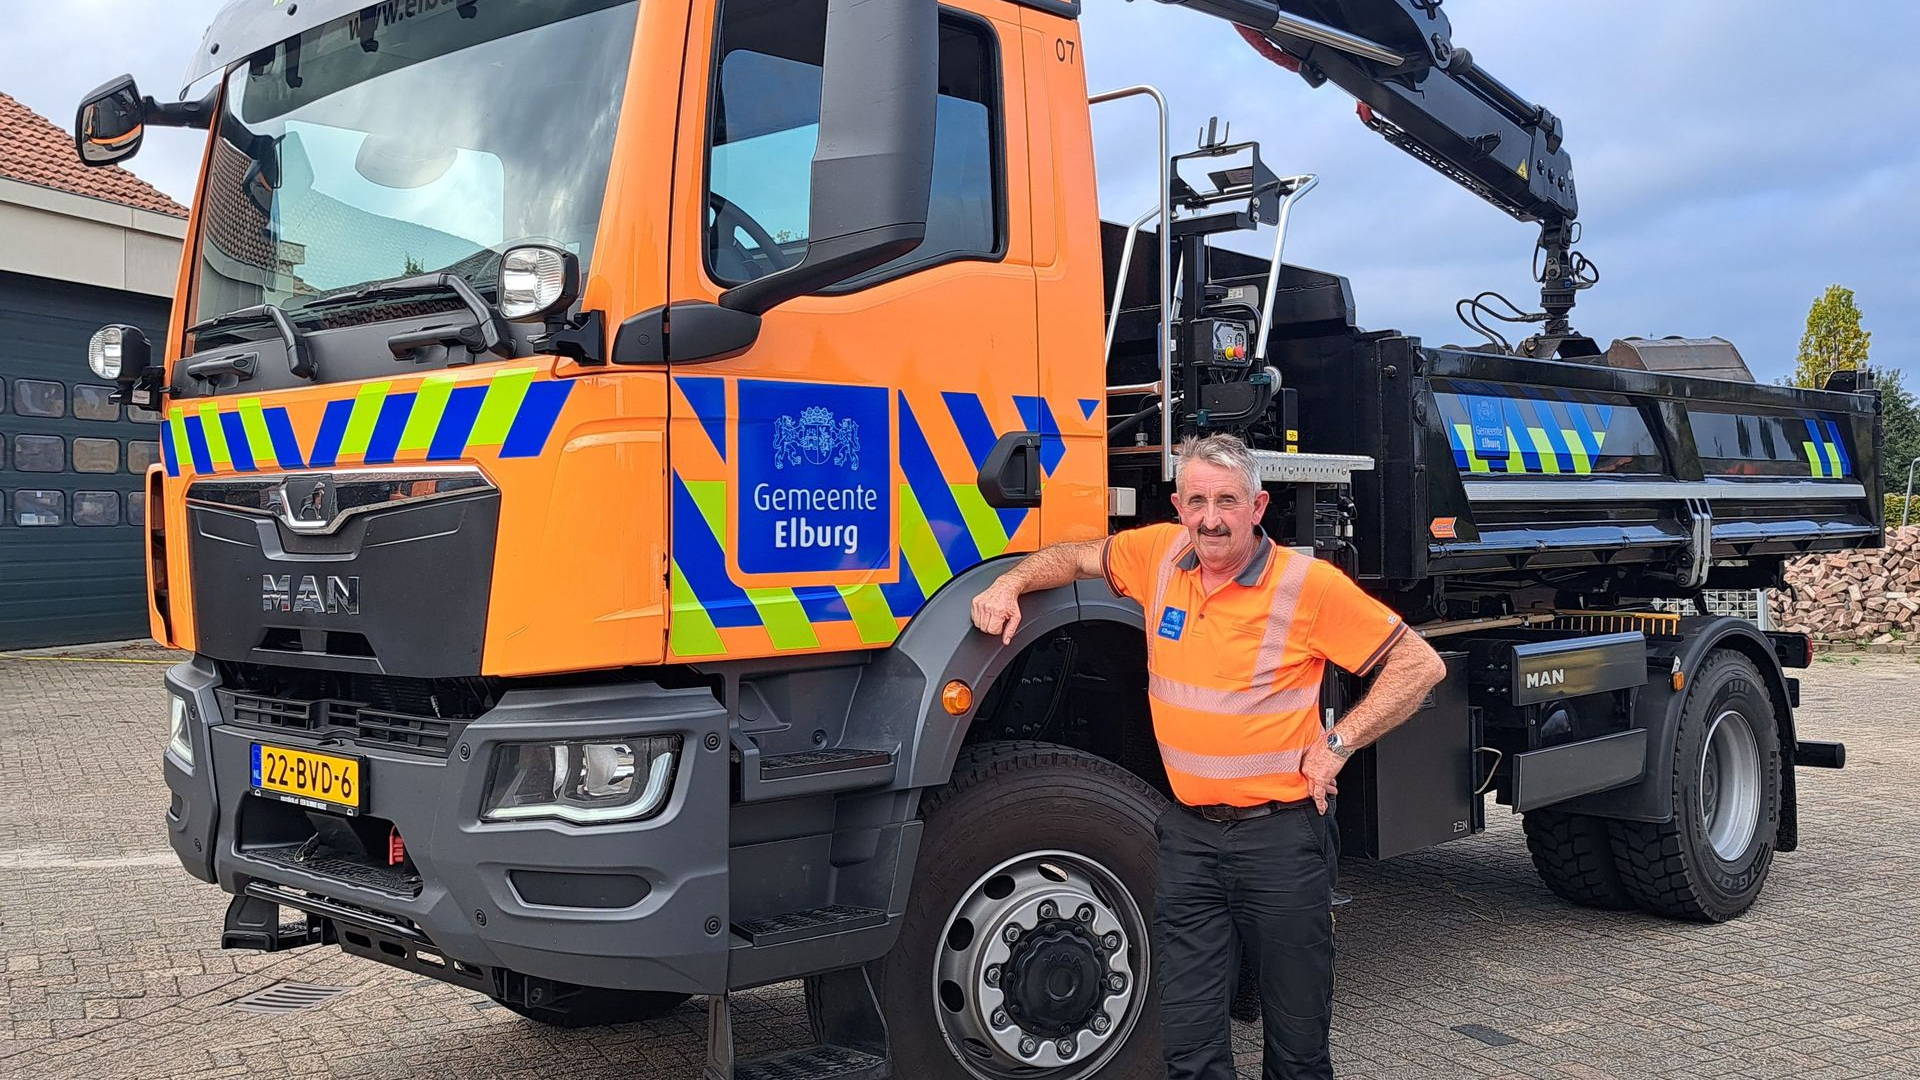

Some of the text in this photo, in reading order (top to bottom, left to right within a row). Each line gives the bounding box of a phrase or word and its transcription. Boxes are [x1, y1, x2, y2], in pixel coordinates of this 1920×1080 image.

[1055, 37, 1075, 65] 07
[1475, 425, 1505, 437] Gemeente
[753, 482, 878, 511] Gemeente
[774, 516, 859, 555] Elburg
[262, 574, 360, 615] MAN
[1526, 668, 1564, 689] MAN
[253, 769, 262, 780] NL
[266, 752, 353, 799] 22-BVD-6
[1453, 819, 1468, 833] ZEN
